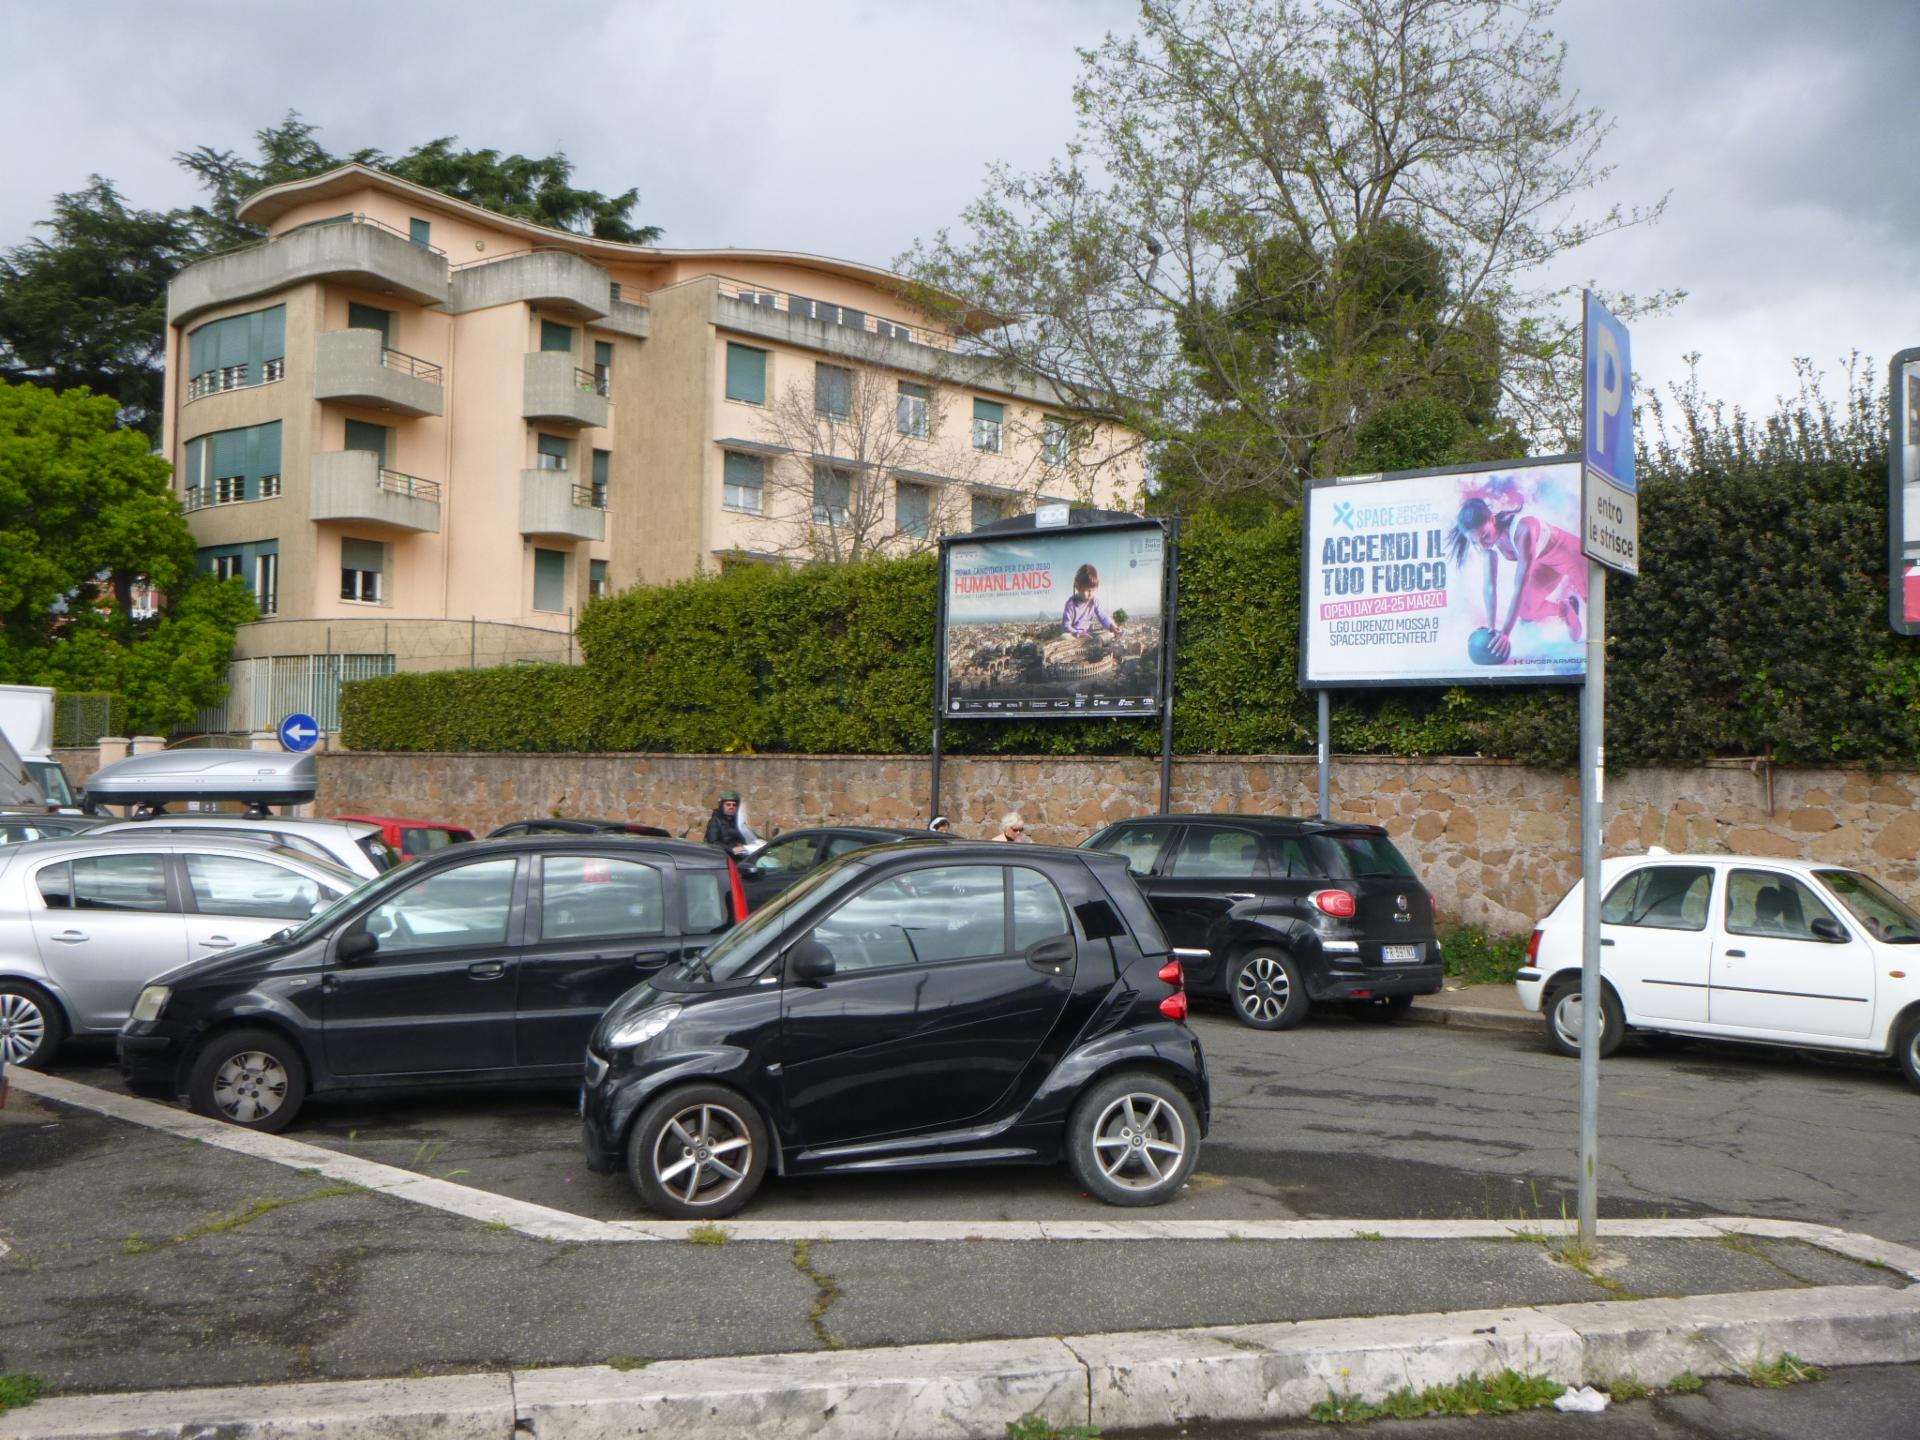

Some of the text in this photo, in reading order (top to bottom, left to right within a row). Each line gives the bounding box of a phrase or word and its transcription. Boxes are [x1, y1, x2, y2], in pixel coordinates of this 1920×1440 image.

[1597, 320, 1622, 454] P
[1356, 507, 1395, 528] SPACE
[1397, 504, 1433, 515] SPORT
[1397, 513, 1440, 525] CENTER
[1597, 496, 1623, 524] entro
[1322, 529, 1446, 565] ACCENDI IL
[1589, 515, 1633, 558] le strisce
[954, 570, 1052, 594] HUMANLANDS
[1322, 561, 1447, 596] TUO FUOCO
[1324, 592, 1443, 619] OPEN DAY 24-25 MARZO
[1329, 617, 1439, 633] L.GO LORENZO MOSSA 8
[1329, 630, 1438, 646] SPACESPORTCENTER.IT
